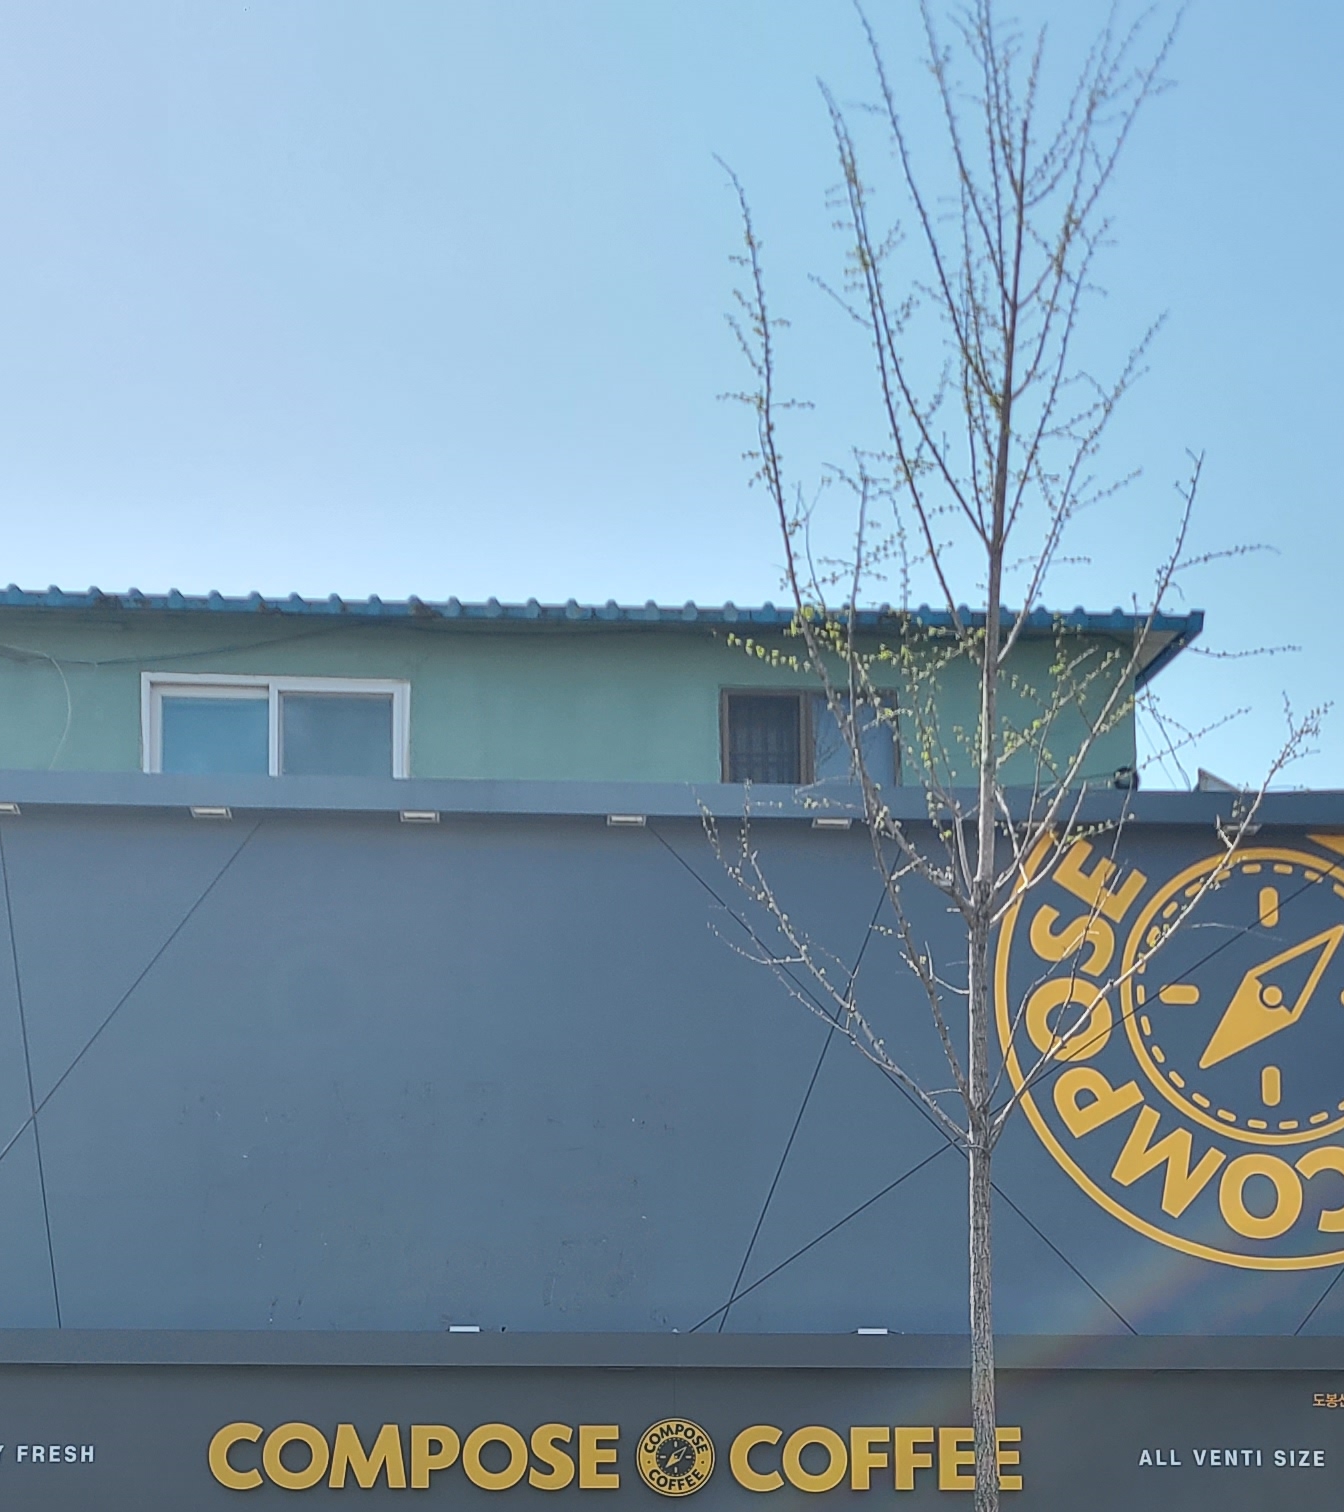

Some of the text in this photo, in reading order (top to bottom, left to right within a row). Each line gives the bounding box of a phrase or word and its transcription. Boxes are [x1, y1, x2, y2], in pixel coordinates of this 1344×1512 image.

[644, 1423, 708, 1454] COMPOSE
[16, 1445, 95, 1463] FRESH
[207, 1421, 1024, 1492] COMPOSE COFFEE
[1139, 1449, 1325, 1467] ALL VENTI SIZE
[649, 1468, 704, 1490] COFFEE
